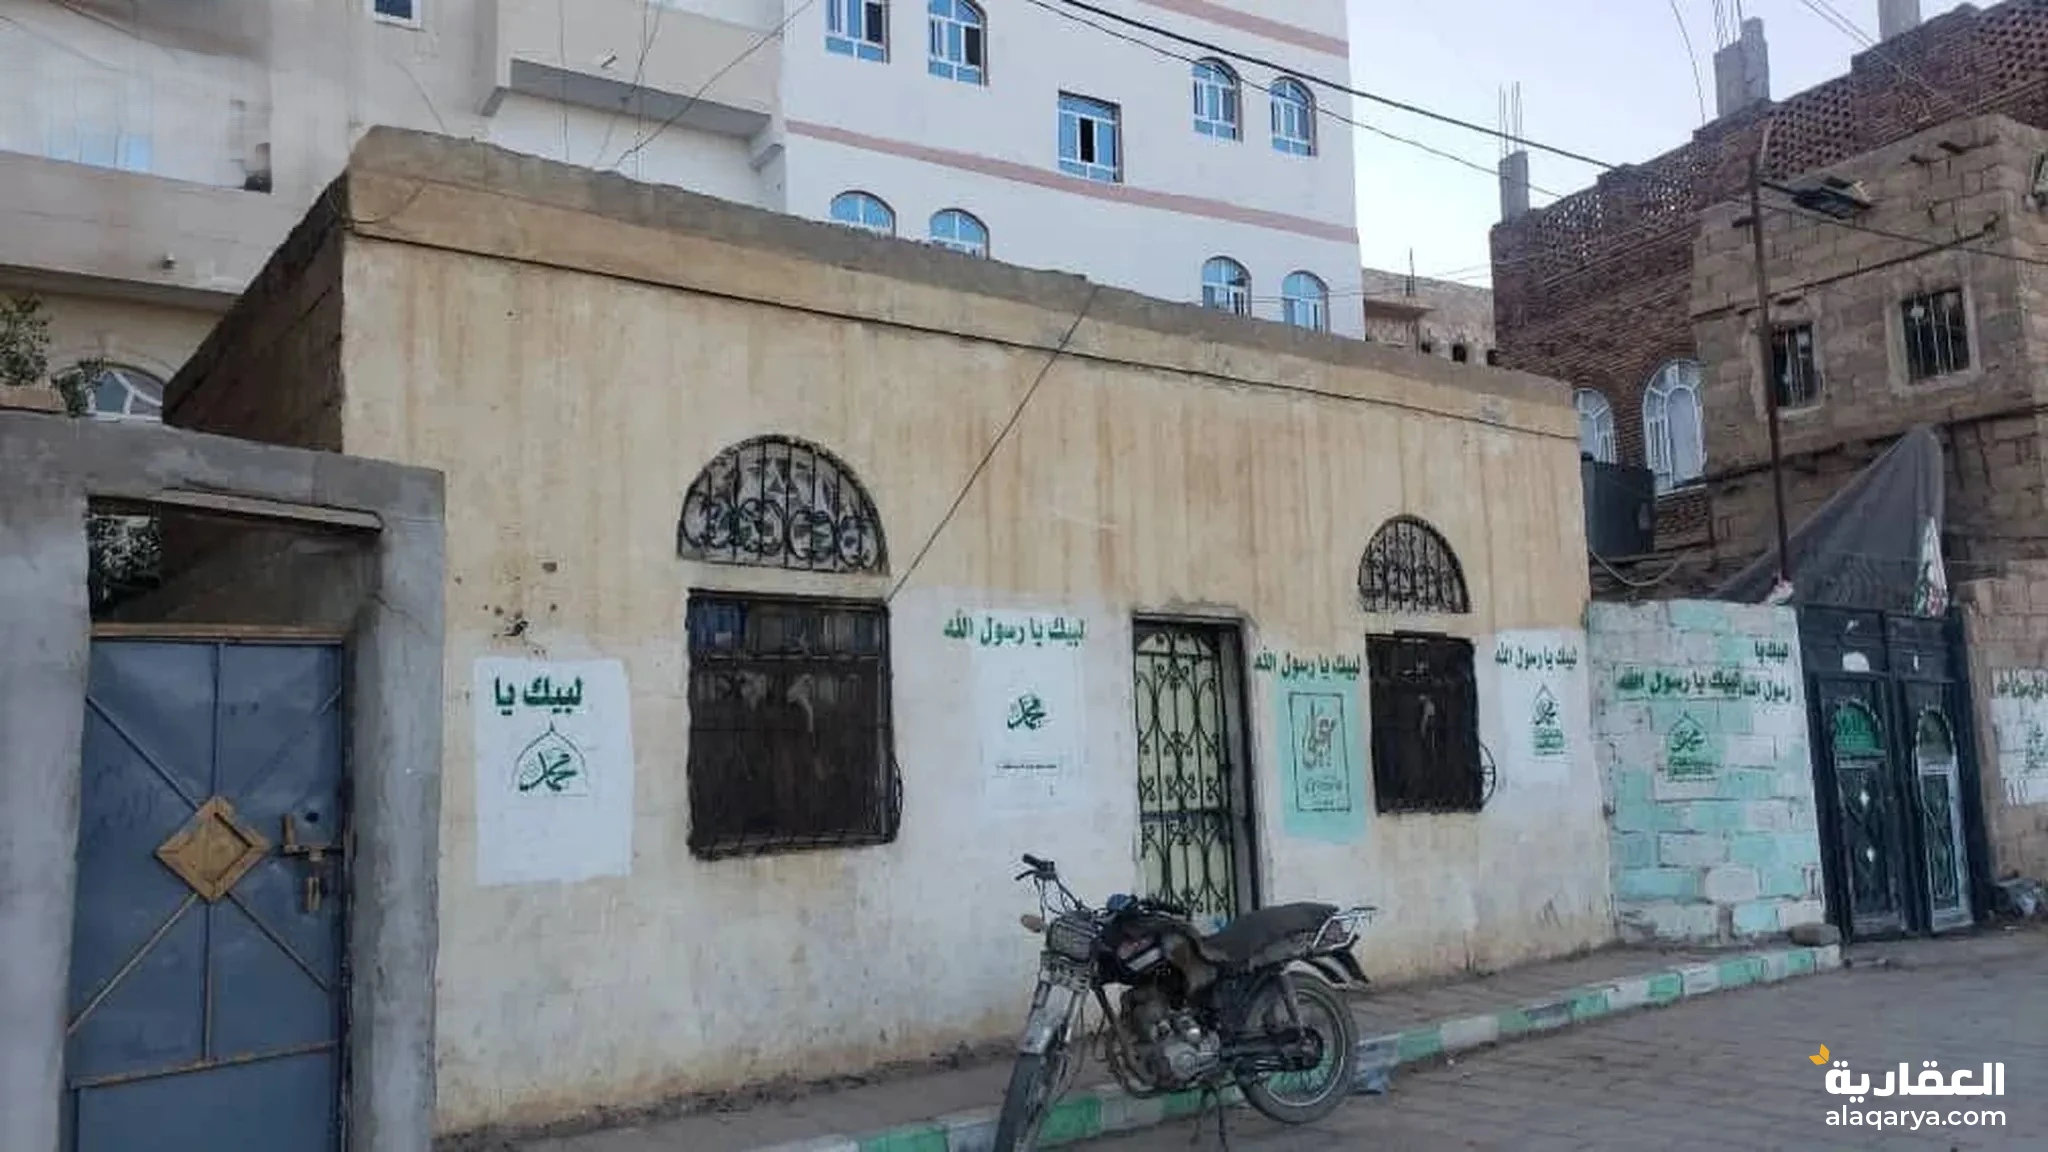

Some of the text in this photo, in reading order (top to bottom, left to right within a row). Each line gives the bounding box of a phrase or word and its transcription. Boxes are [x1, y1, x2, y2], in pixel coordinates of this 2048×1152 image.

[943, 609, 1085, 647] لبيك يا رسول الله
[1254, 646, 1277, 672] الله
[1281, 652, 1316, 680] رسول
[1617, 666, 1645, 690] الله
[1650, 670, 1690, 694] رسول
[495, 676, 582, 716] لبيك يا
